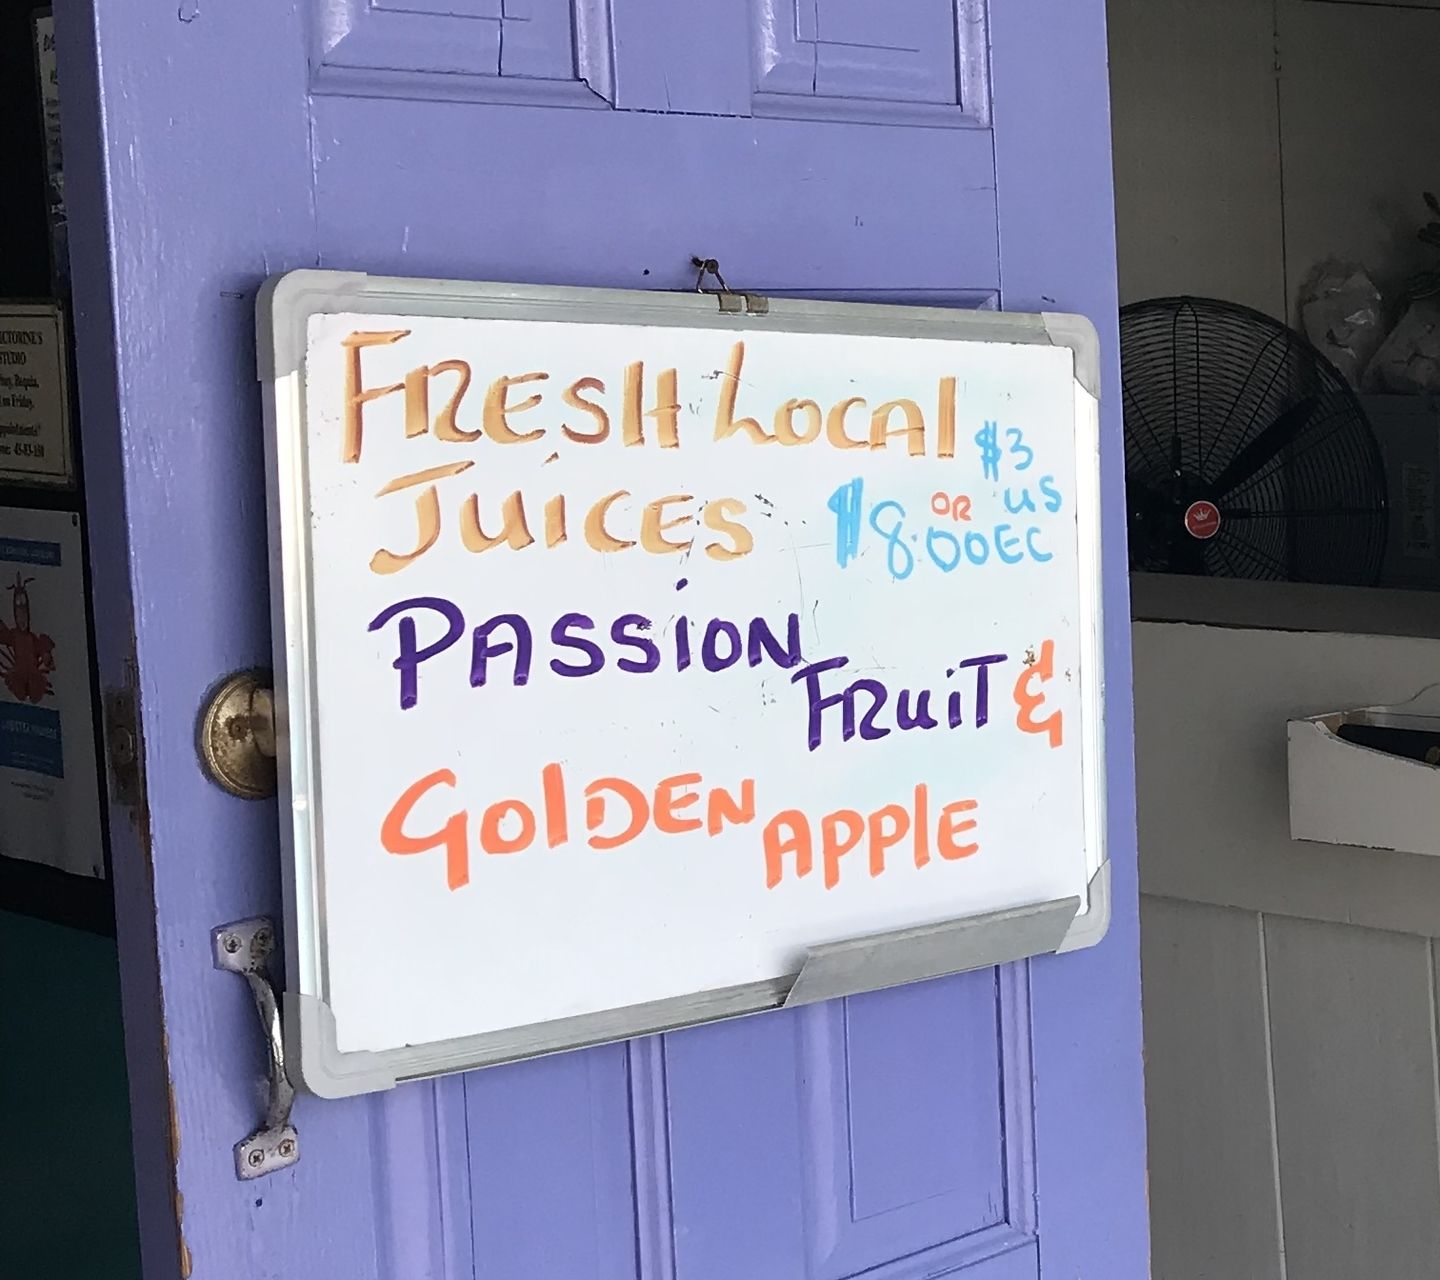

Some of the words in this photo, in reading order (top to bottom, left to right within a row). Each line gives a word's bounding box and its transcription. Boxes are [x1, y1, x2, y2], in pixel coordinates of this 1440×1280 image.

[340, 329, 682, 464] FRESH
[974, 420, 1034, 482] $3
[930, 491, 972, 522] OR
[1012, 639, 1064, 748] &
